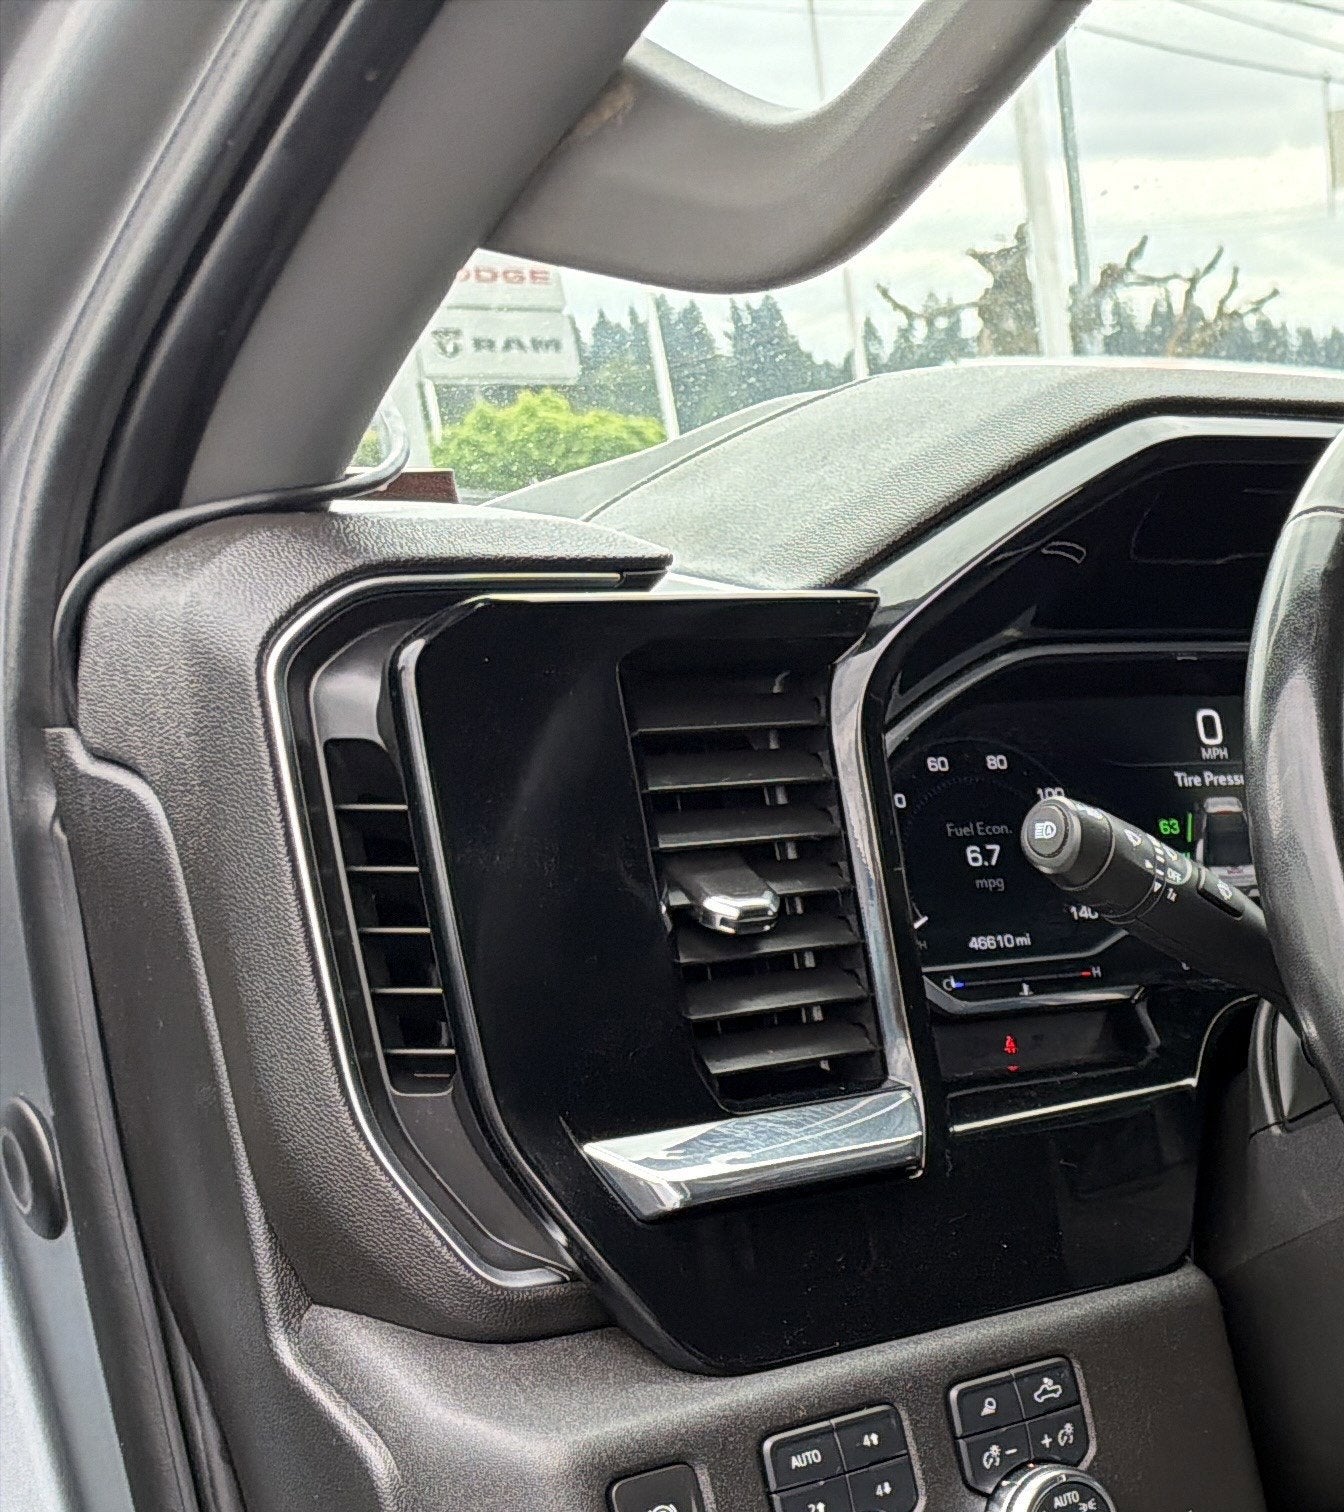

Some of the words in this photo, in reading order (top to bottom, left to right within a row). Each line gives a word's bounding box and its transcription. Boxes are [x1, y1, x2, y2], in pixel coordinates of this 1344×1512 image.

[473, 337, 562, 353] RAM
[1196, 708, 1223, 745] 0
[1201, 747, 1228, 760] MPH
[927, 757, 949, 771] 60
[986, 755, 1007, 770] 80
[1174, 771, 1202, 788] Tire
[946, 822, 974, 837] Fuel
[977, 821, 1013, 836] Econ.
[1158, 818, 1181, 835] 63
[965, 844, 1000, 867] 6.7
[975, 877, 1005, 892] mpg
[968, 934, 1014, 950] 46610
[1016, 933, 1031, 946] mi
[1092, 966, 1102, 978] H
[791, 1449, 822, 1470] AUTO
[1053, 1490, 1080, 1510] AUTO
